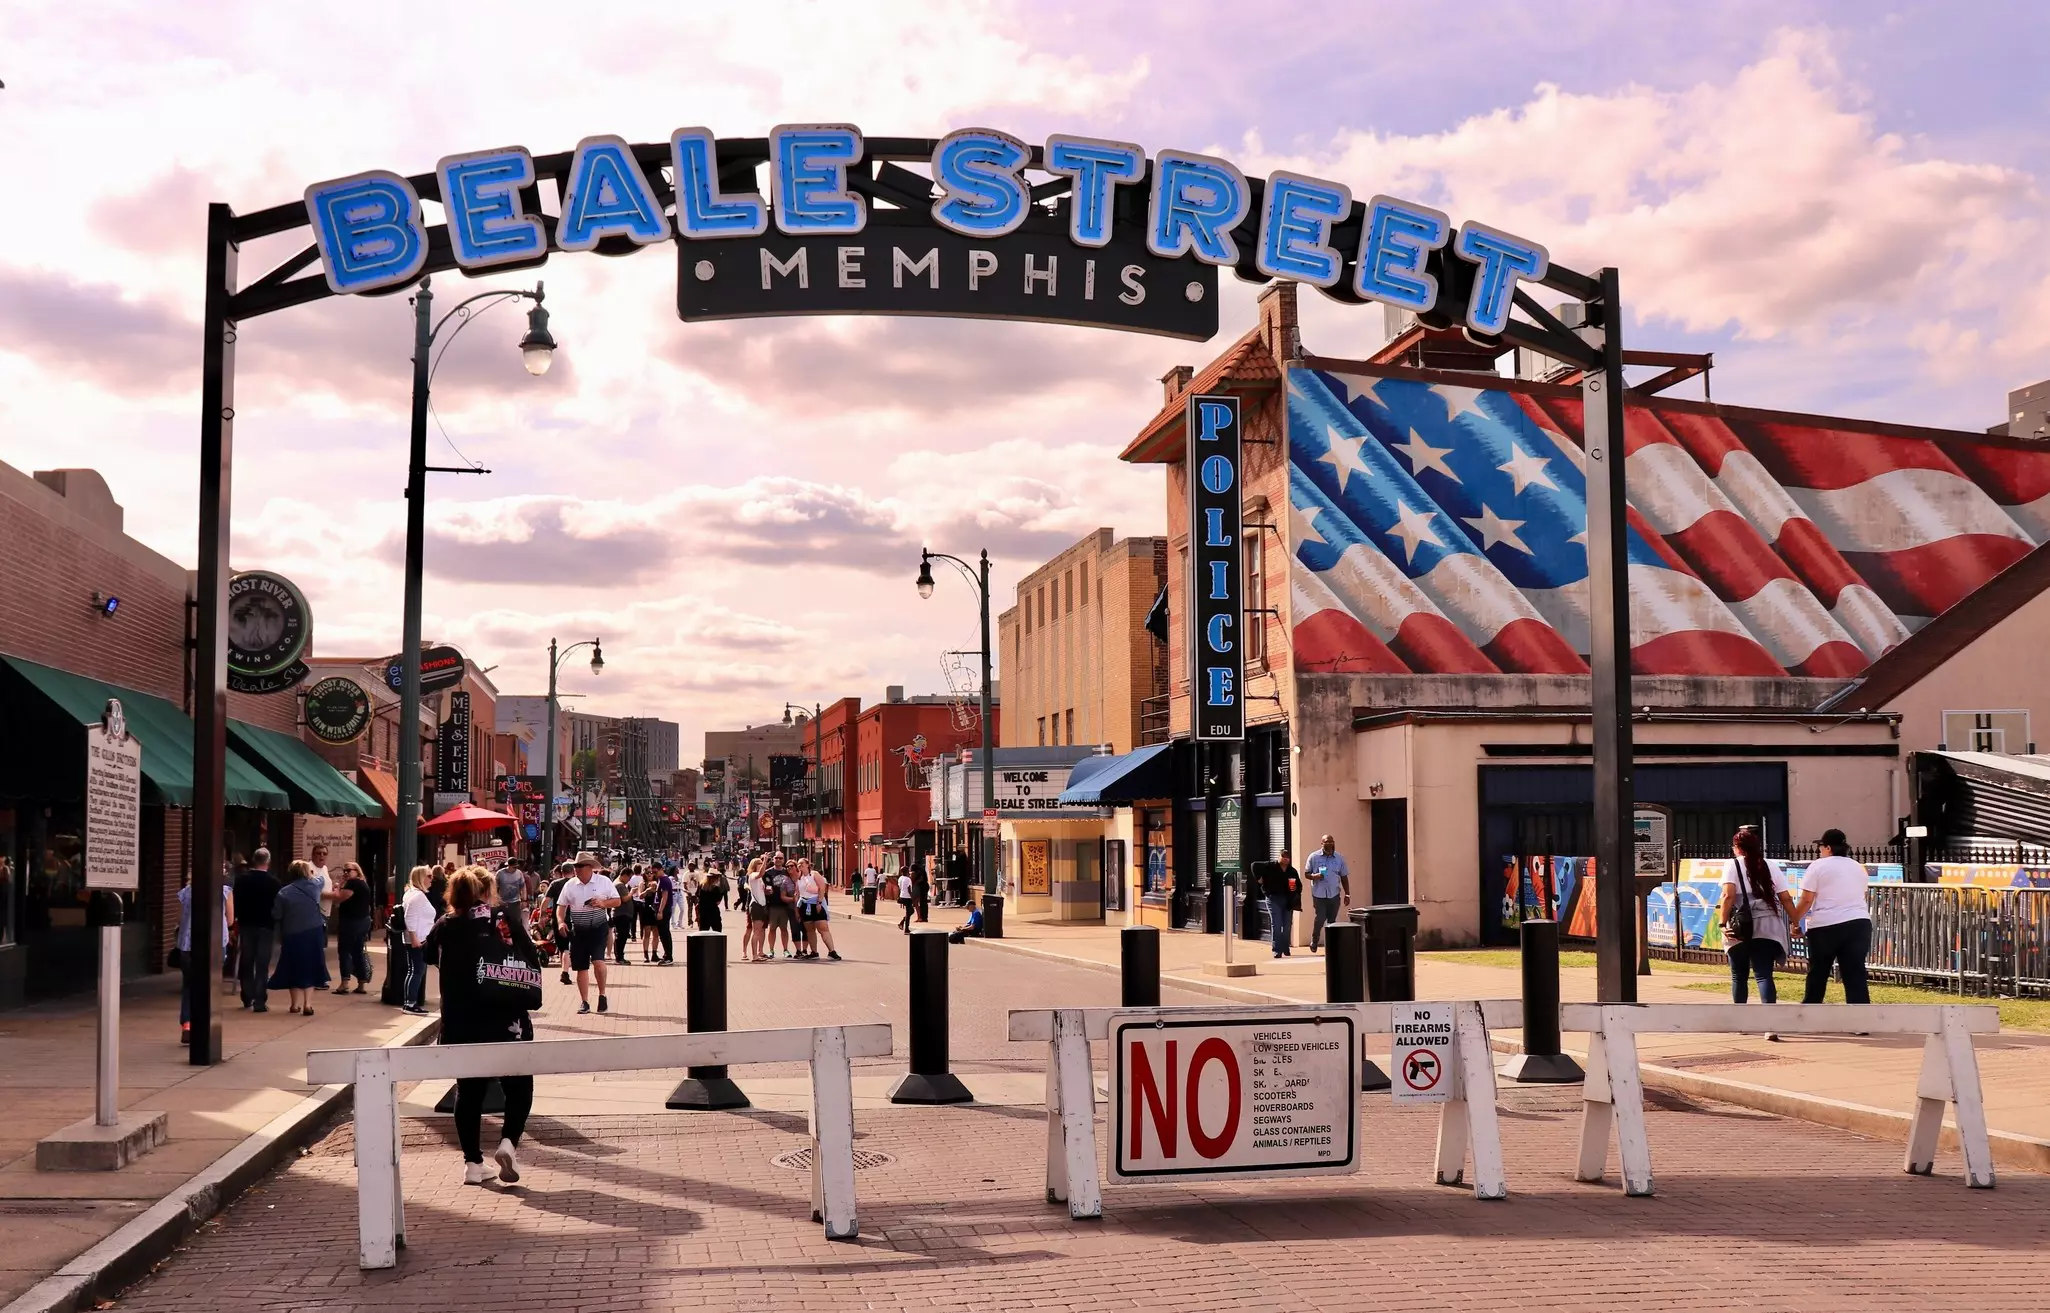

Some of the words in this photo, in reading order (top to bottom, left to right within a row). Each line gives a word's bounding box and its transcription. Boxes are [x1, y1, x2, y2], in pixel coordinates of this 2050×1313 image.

[304, 123, 866, 295] BEALE
[931, 127, 1549, 336] STREET
[760, 247, 1146, 305] MEMPHIS
[1199, 402, 1234, 706] POLICE
[260, 580, 293, 609] RIVER
[418, 656, 457, 672] ASHIONS
[313, 680, 337, 697] GHOST
[339, 680, 361, 697] RIVER
[1210, 725, 1231, 735] EDU
[451, 697, 465, 790] MUSEUM
[1003, 772, 1048, 783] WELCOME
[1016, 785, 1031, 796] TO
[994, 799, 1024, 809] BEALE
[481, 850, 507, 858] SHIRTS
[1414, 1011, 1431, 1020] NO
[1394, 1023, 1451, 1034] FIREARMS
[1253, 1032, 1292, 1041] VEHICLES
[1395, 1036, 1449, 1046] ALLOWED
[1253, 1044, 1271, 1053] LOW
[1273, 1043, 1300, 1052] SPEED
[1301, 1042, 1340, 1051] VEHICLES
[1130, 1037, 1242, 1160] NO
[1253, 1091, 1297, 1101] SCOOTERS
[1253, 1102, 1314, 1113] HOVERBOARDS
[1253, 1115, 1292, 1125] SEGWAYS
[1253, 1127, 1280, 1137] GLASS
[1281, 1125, 1332, 1135] CONTAINERS
[1252, 1139, 1288, 1149] ANIMALS
[1294, 1136, 1332, 1146] REPTILES
